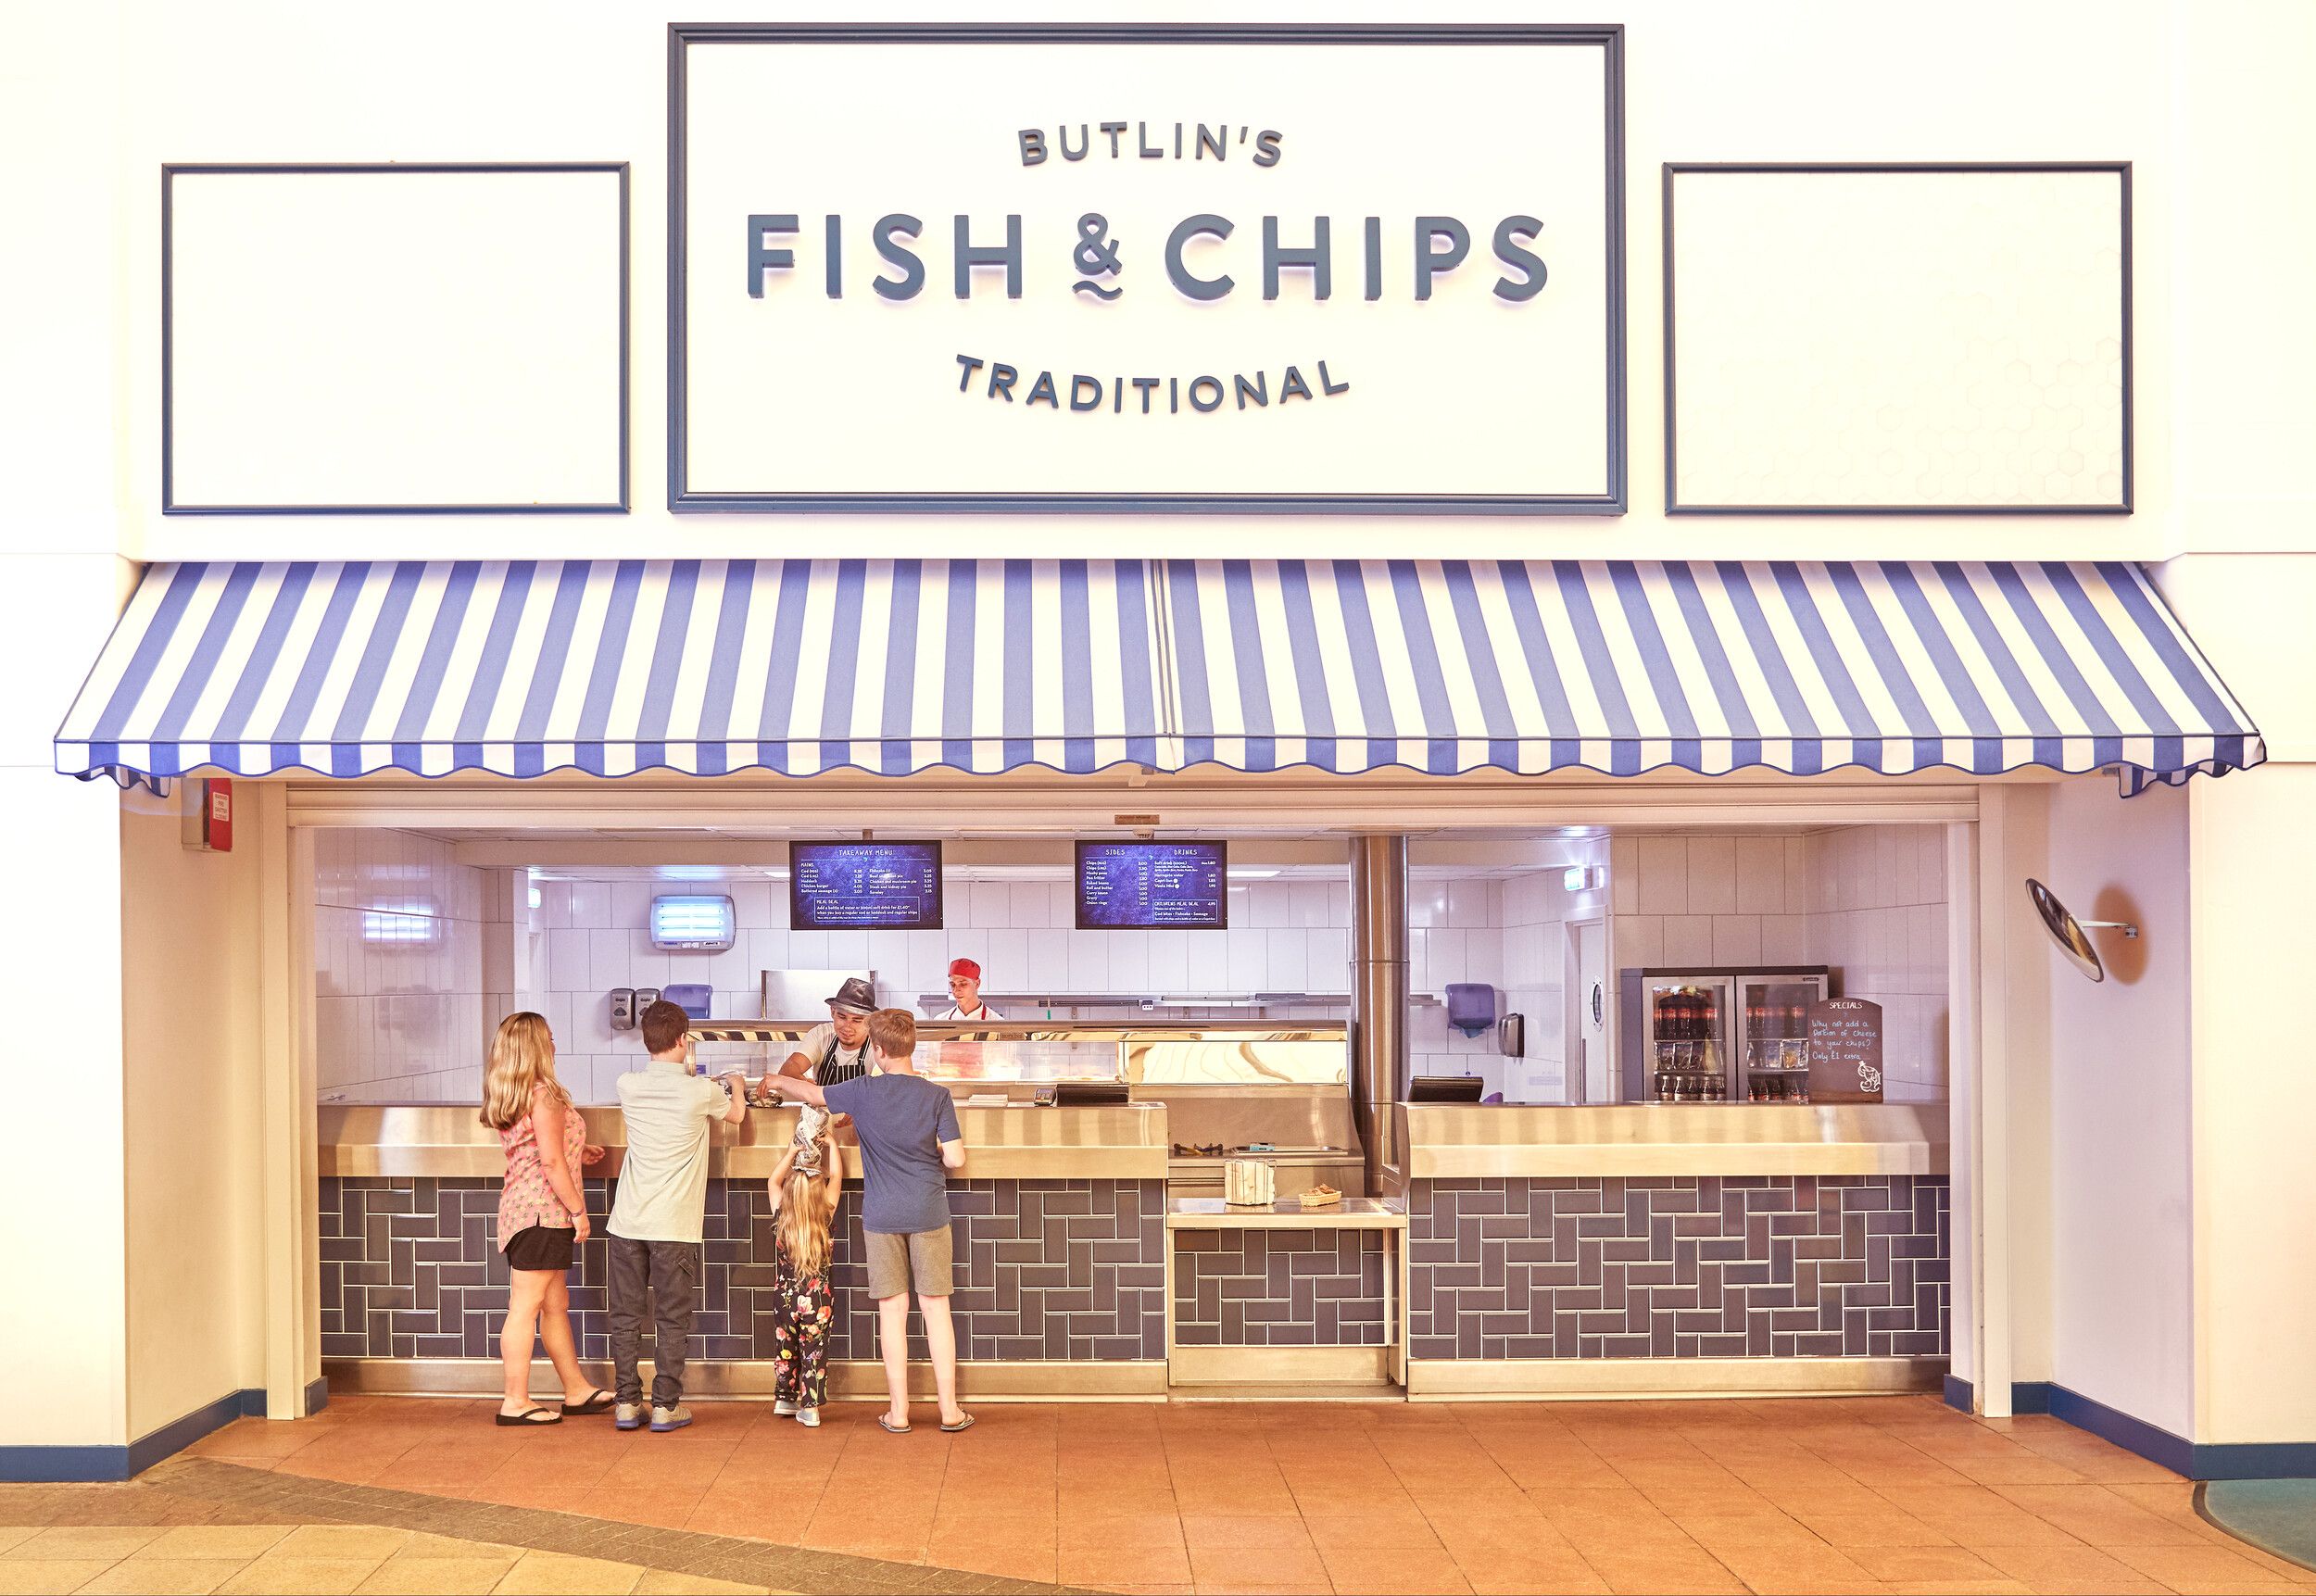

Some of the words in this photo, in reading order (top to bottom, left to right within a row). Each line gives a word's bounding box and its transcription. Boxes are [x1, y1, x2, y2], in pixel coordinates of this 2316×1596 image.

[1019, 122, 1282, 168] BUTLIN'S
[748, 214, 1022, 300] FISH
[1073, 213, 1123, 276] &
[1165, 214, 1547, 301] CHIPS
[957, 355, 1349, 413] TRADITIONAL
[1812, 1020, 1827, 1030] Why
[1813, 1051, 1828, 1063] Only
[1831, 1051, 1840, 1060] £1
[1827, 1040, 1842, 1050] your
